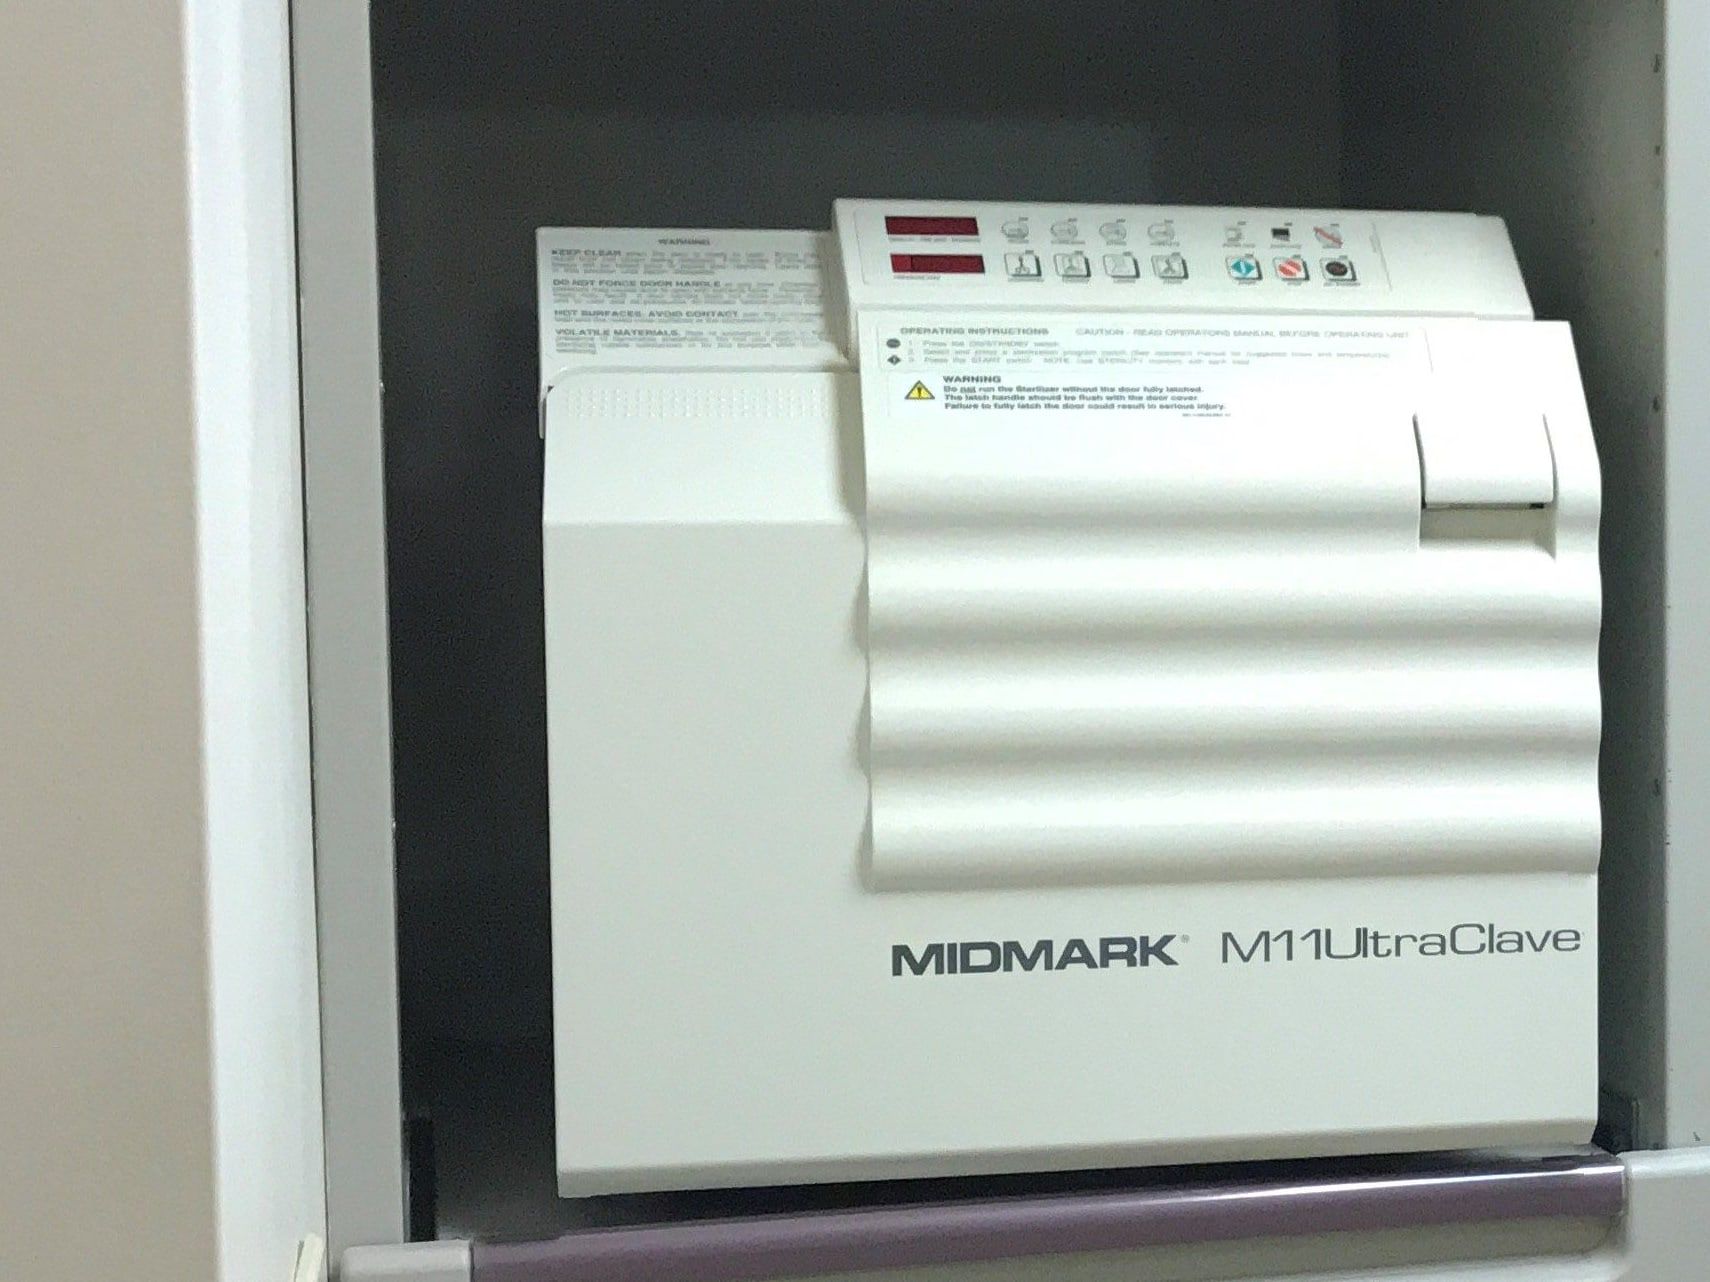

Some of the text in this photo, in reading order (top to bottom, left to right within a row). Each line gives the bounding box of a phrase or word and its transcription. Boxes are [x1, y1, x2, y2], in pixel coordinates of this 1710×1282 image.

[899, 327, 1050, 336] OPERATING INSTRUCTIONS
[942, 375, 1002, 384] WARNING
[943, 385, 959, 393] Do
[998, 385, 1015, 393] the
[1016, 385, 1060, 394] Sterilizer
[1062, 385, 1099, 394] without
[1100, 386, 1116, 394] the
[1118, 386, 1141, 394] door
[1143, 386, 1164, 395] fully
[944, 394, 963, 402] The
[965, 394, 991, 402] latch
[992, 394, 1026, 402] handle
[1028, 394, 1062, 403] should
[1063, 394, 1077, 402] be
[1078, 394, 1104, 402] flush
[1105, 394, 1127, 402] with
[1145, 395, 1169, 403] door
[944, 403, 980, 411] Failure
[981, 403, 992, 411] to
[994, 403, 1016, 412] fully
[1017, 403, 1042, 411] latch
[1043, 403, 1060, 411] the
[1062, 403, 1086, 411] door
[1087, 403, 1116, 411] could
[1117, 403, 1147, 411] result
[1148, 403, 1158, 411] in
[1159, 403, 1195, 411] serious
[892, 934, 1179, 977] MIDMARK
